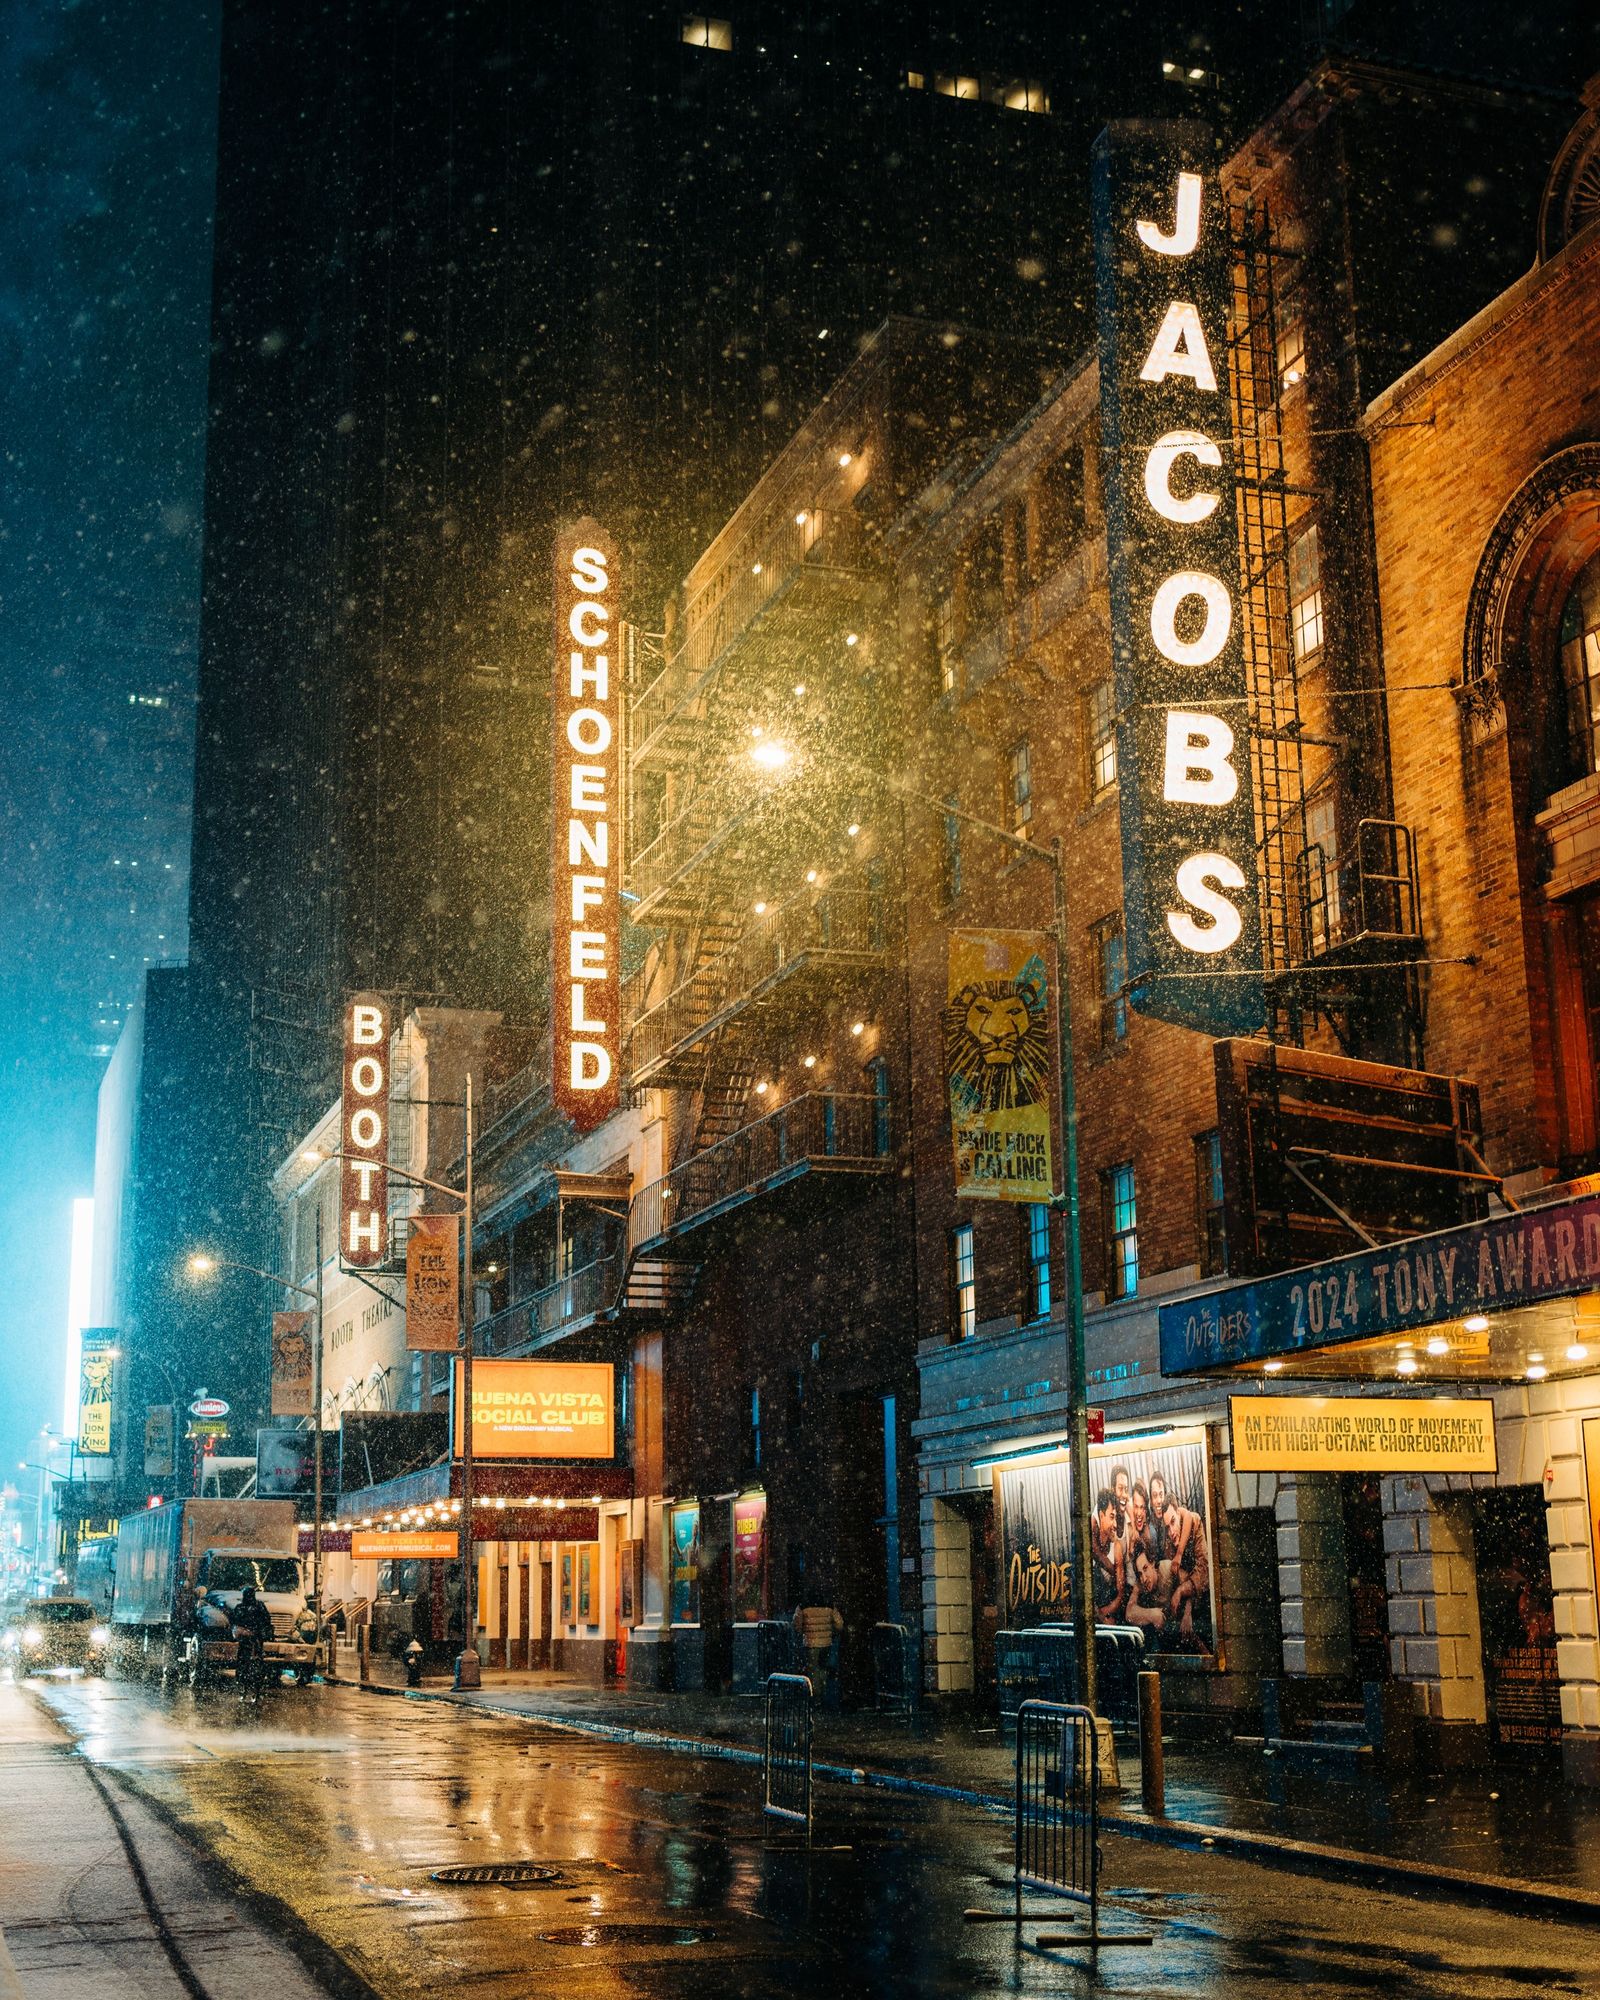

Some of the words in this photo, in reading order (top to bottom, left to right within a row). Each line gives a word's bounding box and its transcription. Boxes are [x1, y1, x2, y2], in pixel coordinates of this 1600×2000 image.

[1136, 171, 1247, 955] JACOBS
[566, 547, 612, 1090] SCHOENFELD
[349, 1004, 383, 1251] BOOTH
[957, 1131, 1003, 1152] PRIDE
[1005, 1132, 1046, 1155] ROCK
[974, 1151, 1048, 1182] CALLING
[1290, 1269, 1360, 1338] 2024
[1372, 1247, 1457, 1320] TONY
[331, 1319, 354, 1353] BOOTH
[361, 1297, 393, 1334] THEATRE
[1185, 1310, 1252, 1358] OUTSIDERS
[538, 1392, 605, 1408] VISTA
[88, 1412, 103, 1420] THE
[541, 1410, 605, 1425] CLUB
[1266, 1415, 1351, 1433] EXHILARATING
[1355, 1416, 1396, 1434] WORLD
[1400, 1418, 1414, 1434] OF
[1419, 1418, 1484, 1435] MOVEMENT
[84, 1423, 104, 1434] LION
[81, 1436, 106, 1449] KING
[1245, 1432, 1281, 1451] WITH
[1285, 1433, 1377, 1452] HIGH-OCTANE
[1027, 1544, 1041, 1564] THE
[1009, 1552, 1073, 1612] OUTSIDE
